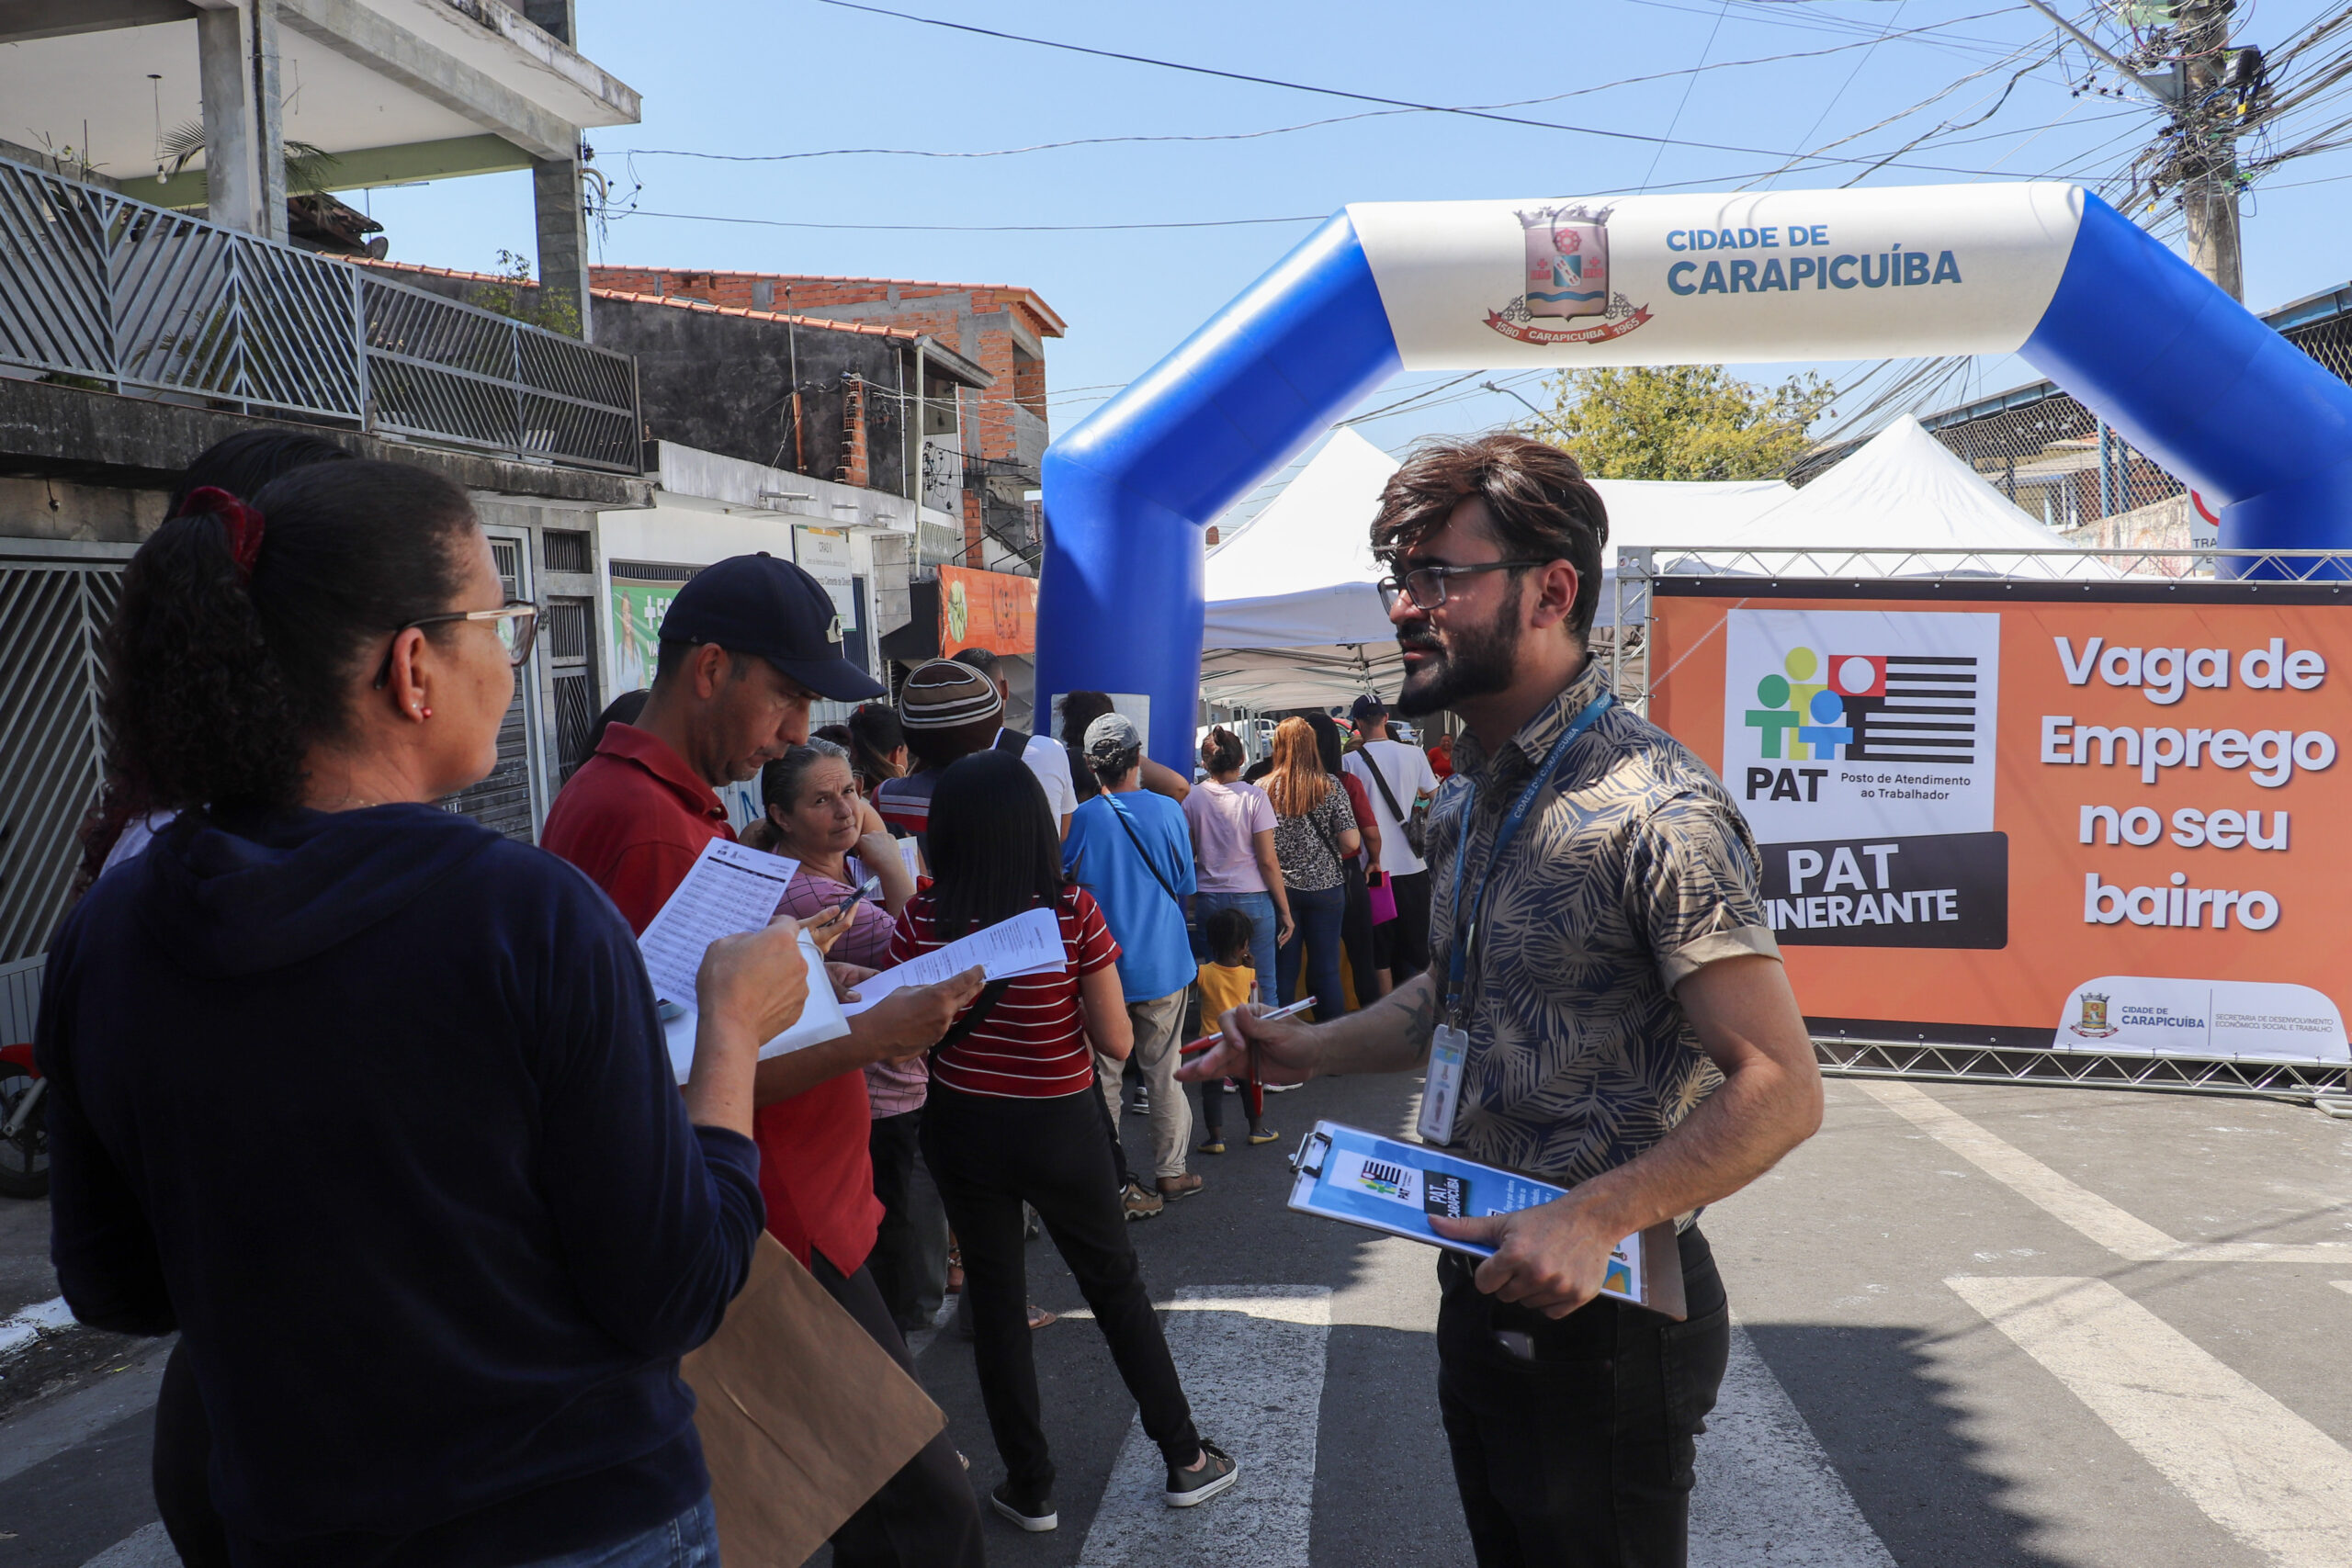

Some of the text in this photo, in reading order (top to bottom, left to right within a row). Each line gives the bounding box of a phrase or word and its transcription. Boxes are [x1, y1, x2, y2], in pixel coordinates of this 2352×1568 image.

[1666, 224, 1830, 252] CIDADE DE
[1667, 243, 1962, 296] CARAPICUÍBA
[1494, 321, 1520, 338] 1580
[1612, 317, 1640, 335] 1965
[2193, 538, 2217, 547] TRA
[2053, 636, 2326, 705] Vaga de
[2040, 715, 2337, 788] Emprego
[1746, 766, 1828, 803] PAT
[1840, 772, 1972, 787] Posto de Atendimento
[1514, 788, 1536, 819] CIDADE
[1860, 788, 1951, 801] ao Trabalhador
[2078, 805, 2289, 851] no seu
[1787, 843, 1900, 896] PAT
[1762, 888, 1960, 931] INERANTE
[2084, 871, 2280, 931] bairro
[2121, 1005, 2169, 1016] CIDADE DE
[2121, 1015, 2205, 1028] CARAPICUÍBA
[2215, 1013, 2256, 1021] SECRETARIA
[2268, 1016, 2335, 1026] DESENVOLVIMENTO
[2262, 1022, 2287, 1031] SOCIAL
[2296, 1024, 2334, 1033] TRABALHO
[1397, 1187, 1412, 1201] PAT
[1429, 1183, 1448, 1205] PAT
